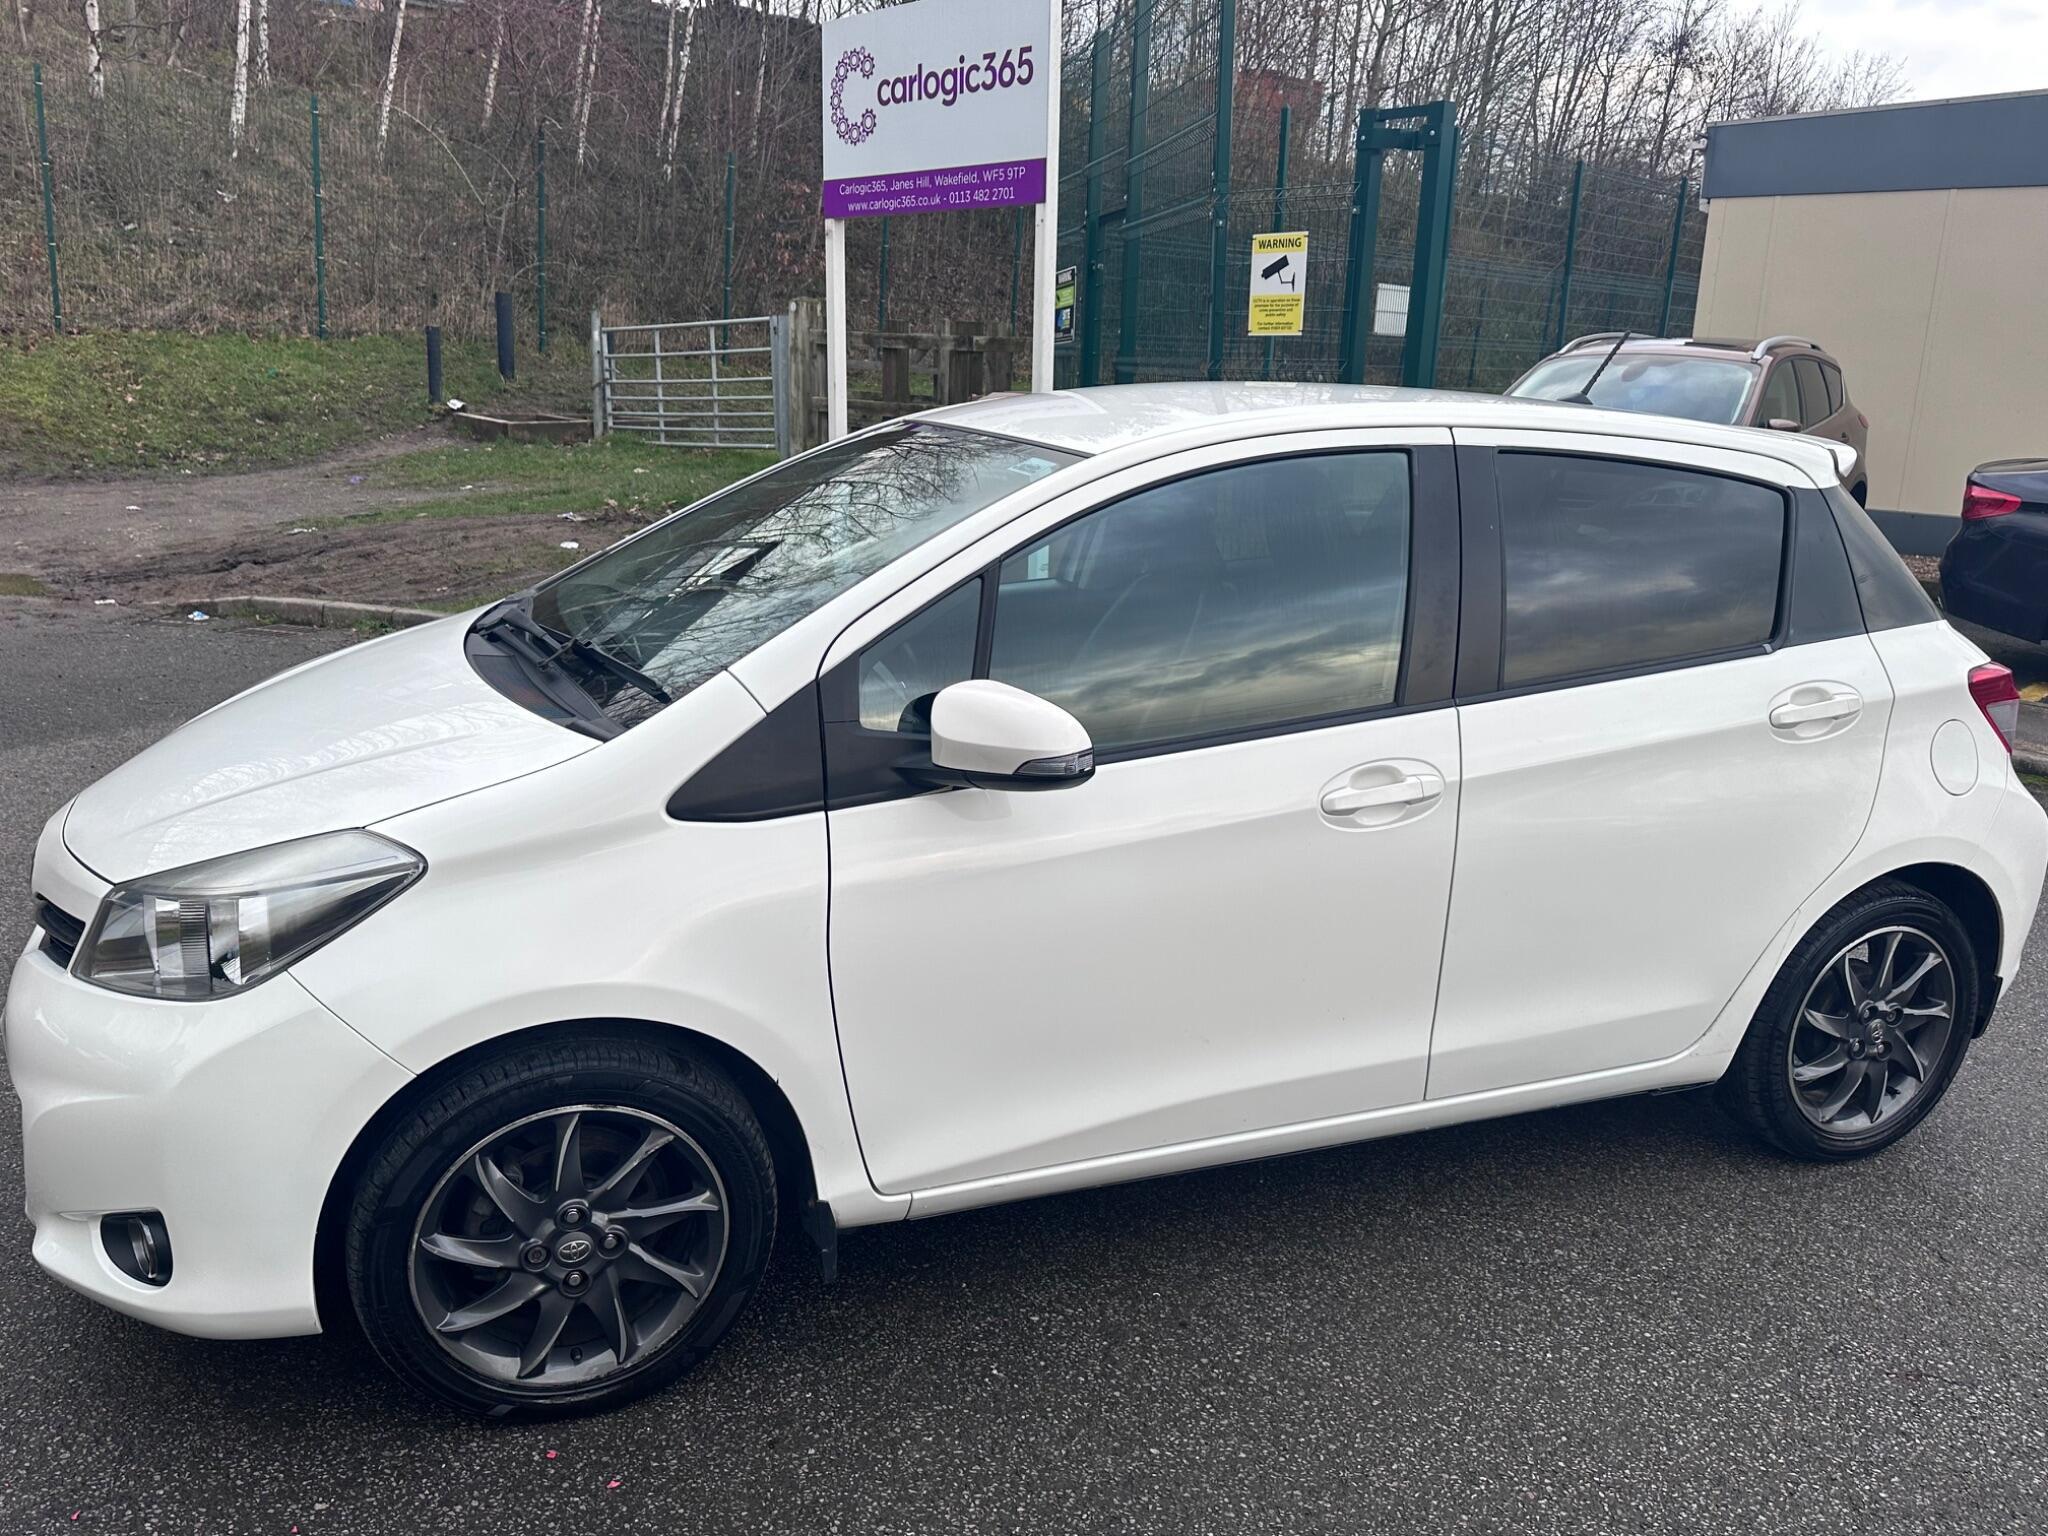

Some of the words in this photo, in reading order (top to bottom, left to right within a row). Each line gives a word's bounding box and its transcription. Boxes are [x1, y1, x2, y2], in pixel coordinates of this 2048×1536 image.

[877, 45, 1034, 107] carlogic365
[839, 180, 889, 195] Carlogic365,
[890, 179, 914, 191] Janes
[916, 175, 932, 188] Hill,
[934, 171, 980, 186] Wakefield,
[983, 168, 1005, 182] WF5
[1007, 166, 1026, 180] 9TP
[847, 193, 941, 211] www.carlogic365.co.uk
[949, 190, 971, 204] 0113
[973, 188, 990, 202] 482
[992, 186, 1015, 200] 2701
[1258, 237, 1302, 249] WARNING
